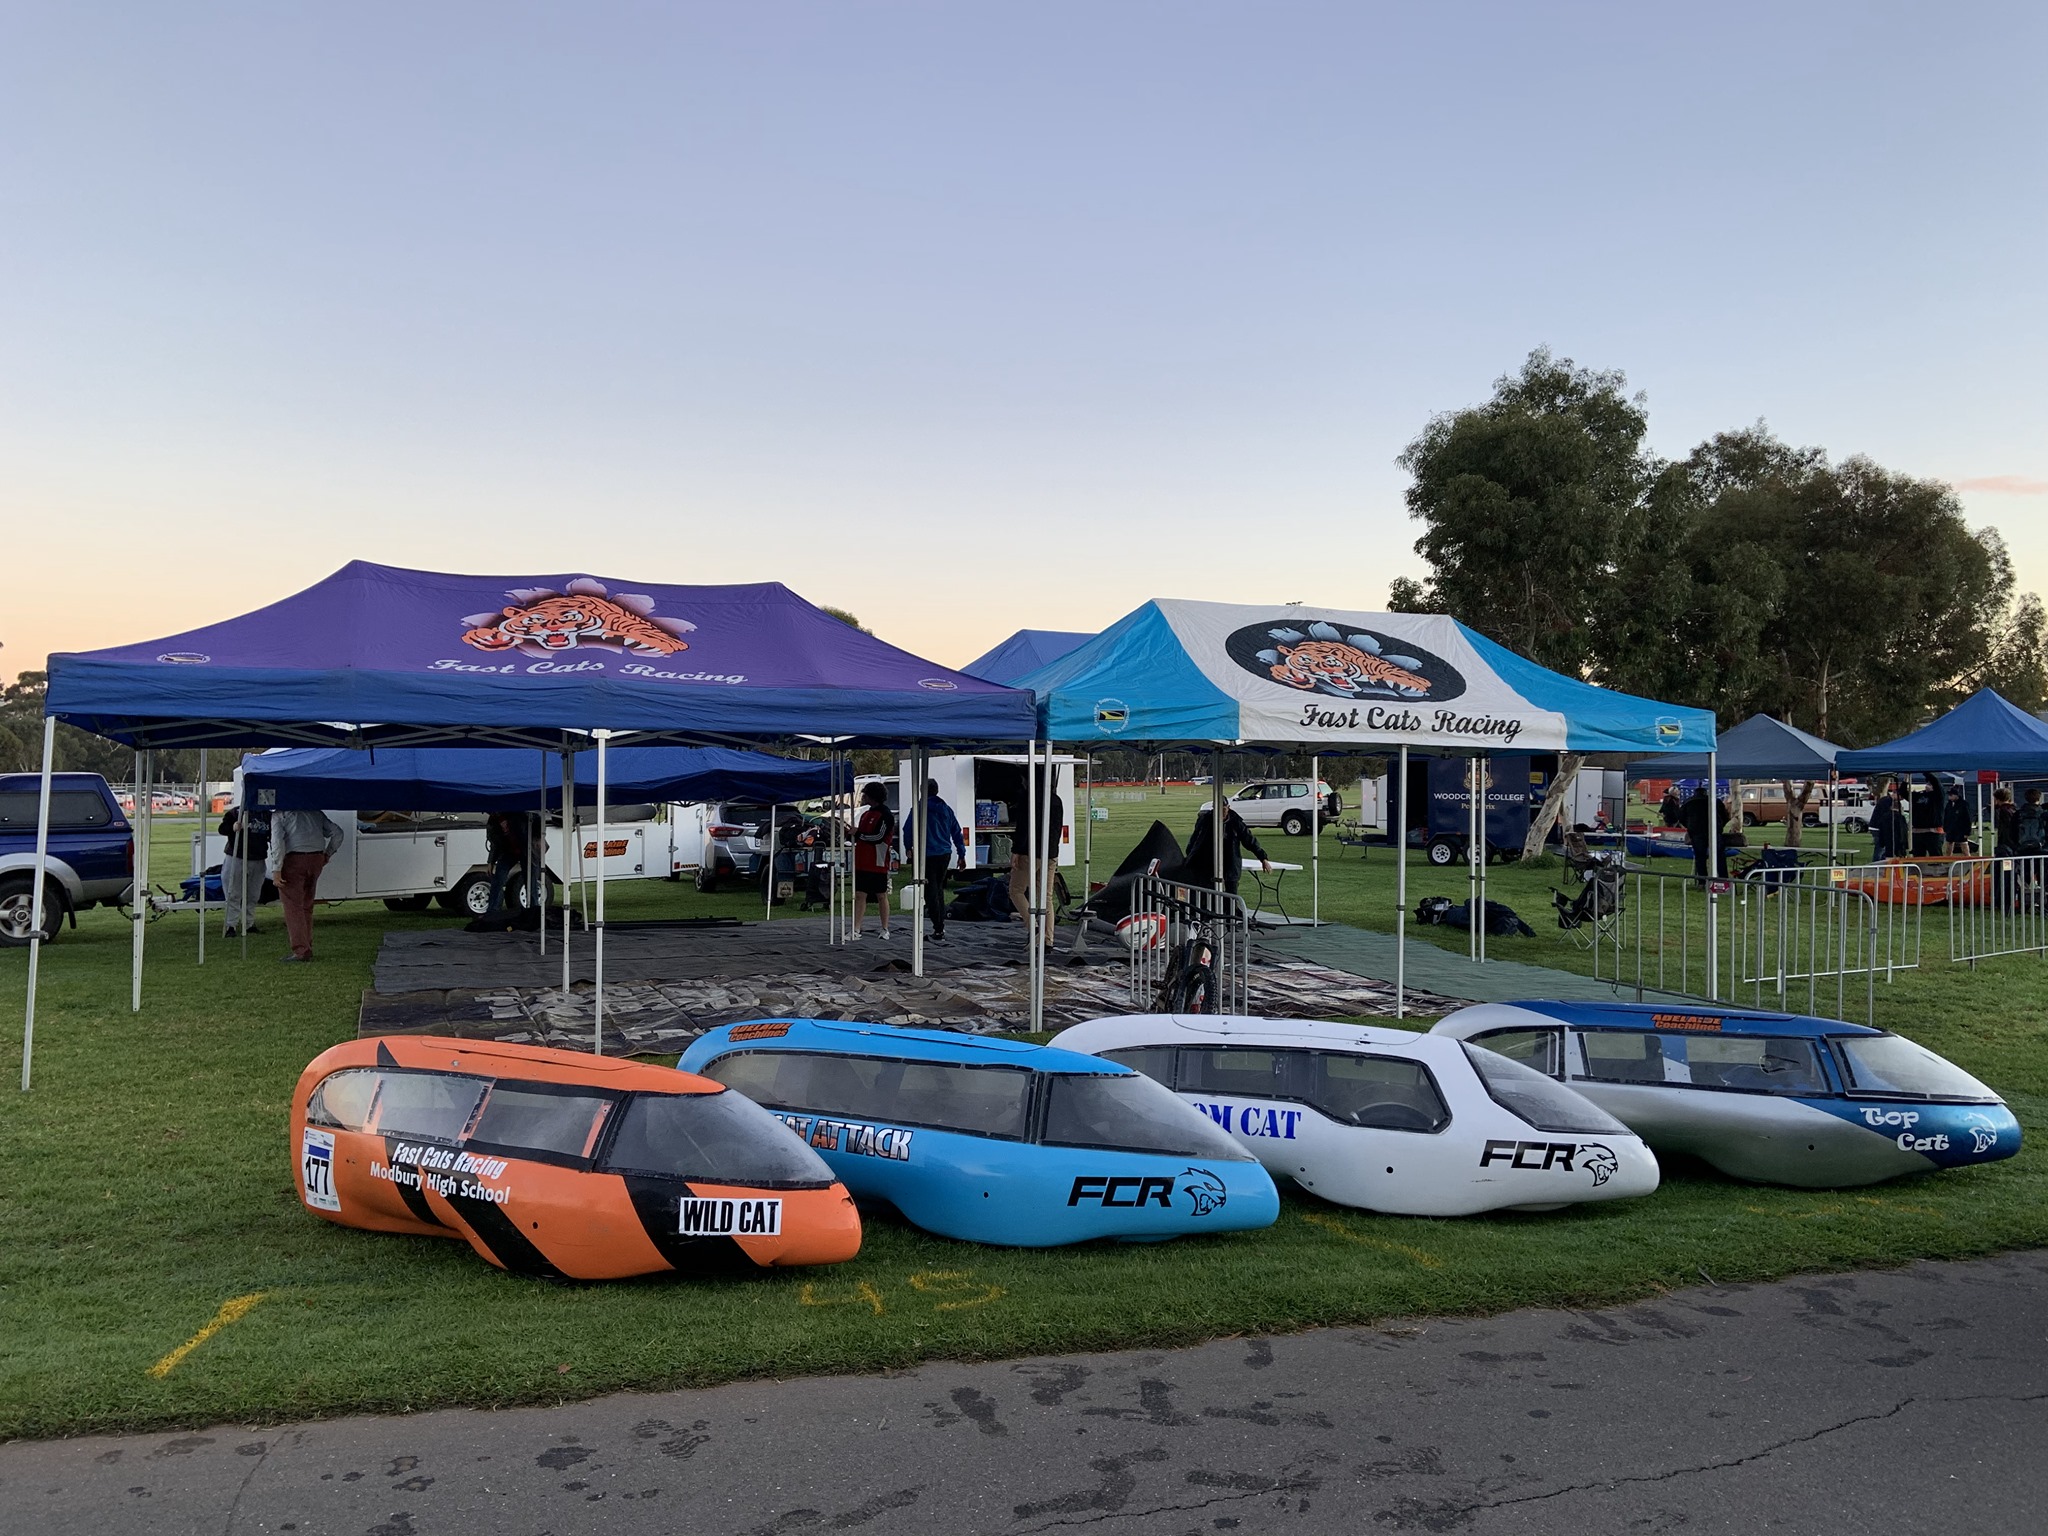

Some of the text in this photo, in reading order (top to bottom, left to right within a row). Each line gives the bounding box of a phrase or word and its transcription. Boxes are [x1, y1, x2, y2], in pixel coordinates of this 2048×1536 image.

[427, 659, 749, 684] Fast Cats Racing
[1300, 704, 1523, 744] Fast Cats Racing
[1488, 793, 1525, 801] COLLEGE
[730, 1023, 793, 1034] ADELAIDE
[1652, 1014, 1721, 1025] ADELAIDE
[1241, 1107, 1301, 1140] CAT
[1859, 1107, 1920, 1129] Top
[774, 1114, 913, 1161] AT ATTACK
[1897, 1133, 1950, 1151] Cat
[392, 1142, 508, 1180] Fast Cats Racing
[1479, 1139, 1577, 1172] FCR
[306, 1156, 329, 1195] 177
[370, 1161, 511, 1204] Modbury High School
[1067, 1176, 1176, 1207] FCR
[684, 1200, 779, 1233] WILD CAT
